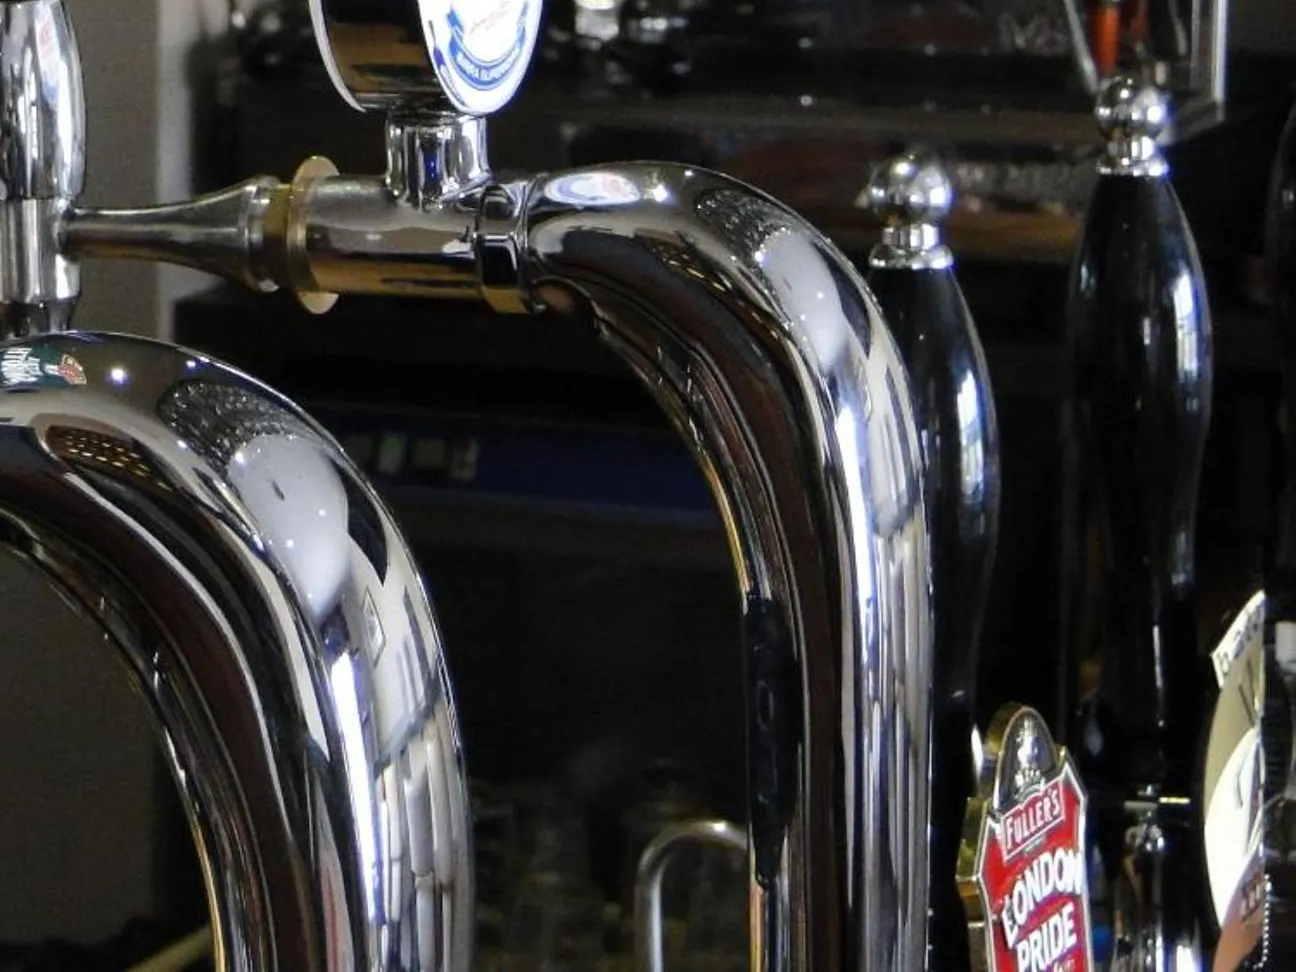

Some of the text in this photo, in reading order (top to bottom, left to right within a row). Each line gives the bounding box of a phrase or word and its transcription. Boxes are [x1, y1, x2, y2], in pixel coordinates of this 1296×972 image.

[1005, 787, 1061, 850] FULLER'S
[1001, 846, 1083, 950] LONDON
[1016, 901, 1078, 972] PRIDE
